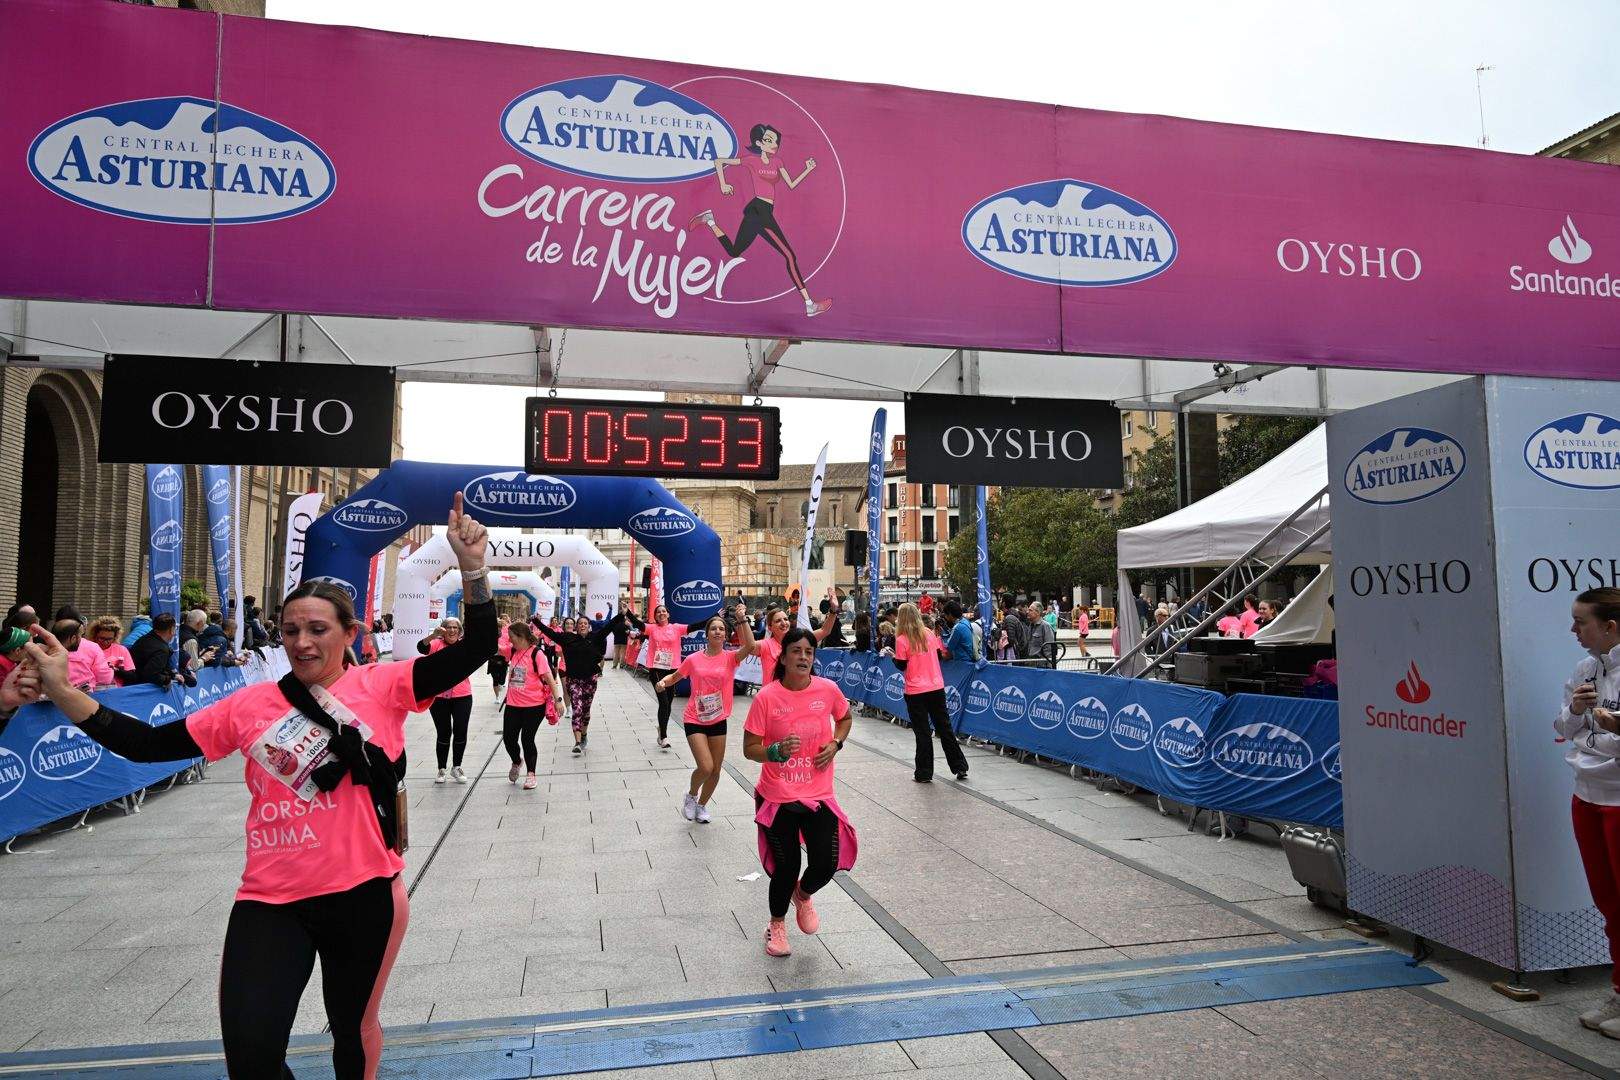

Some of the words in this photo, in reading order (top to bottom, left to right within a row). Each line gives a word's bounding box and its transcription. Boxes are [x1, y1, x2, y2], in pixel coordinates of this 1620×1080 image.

[519, 105, 719, 161] ASTURIANA
[558, 106, 632, 123] CENTRAL
[640, 114, 713, 131] LECHERA
[104, 134, 199, 153] CENTRAL
[209, 142, 304, 161] LECHERA
[52, 134, 313, 198] ASTURIANA
[477, 164, 676, 232] Carrera
[1013, 212, 1081, 227] CENTRAL
[1088, 218, 1155, 232] LECHERA
[980, 212, 1162, 263] ASTURIANA
[526, 227, 563, 264] de
[572, 228, 598, 267] la
[592, 229, 747, 319] Mujer
[1276, 238, 1422, 281] OYSHO
[1509, 265, 1620, 298] Santande
[152, 391, 354, 435] OYSHO
[942, 425, 1092, 462] OYSHO
[1367, 454, 1404, 467] CENTRAL
[1408, 444, 1451, 459] LECHERA
[1535, 440, 1620, 470] ASTURIA
[1555, 438, 1598, 448] CENTRAL
[1601, 439, 1618, 448] LEC
[1352, 456, 1456, 491] ASTURIANA
[472, 483, 568, 506] ASTURIANA
[337, 509, 402, 525] ASTURIANA
[634, 518, 691, 530] ASTURIANA
[287, 512, 312, 592] YSHO
[488, 540, 555, 558] YSHO
[1351, 559, 1471, 597] OYSHO
[1528, 557, 1620, 594] OYS
[675, 591, 720, 602] ASTURIANA
[1030, 703, 1062, 722] ASTURIANA
[1068, 710, 1105, 731] ASTURIANA
[1365, 705, 1467, 738] Santander
[39, 743, 98, 772] ASTURIANA
[1217, 740, 1304, 769] ASTURIANA
[250, 823, 318, 849] SUMA
